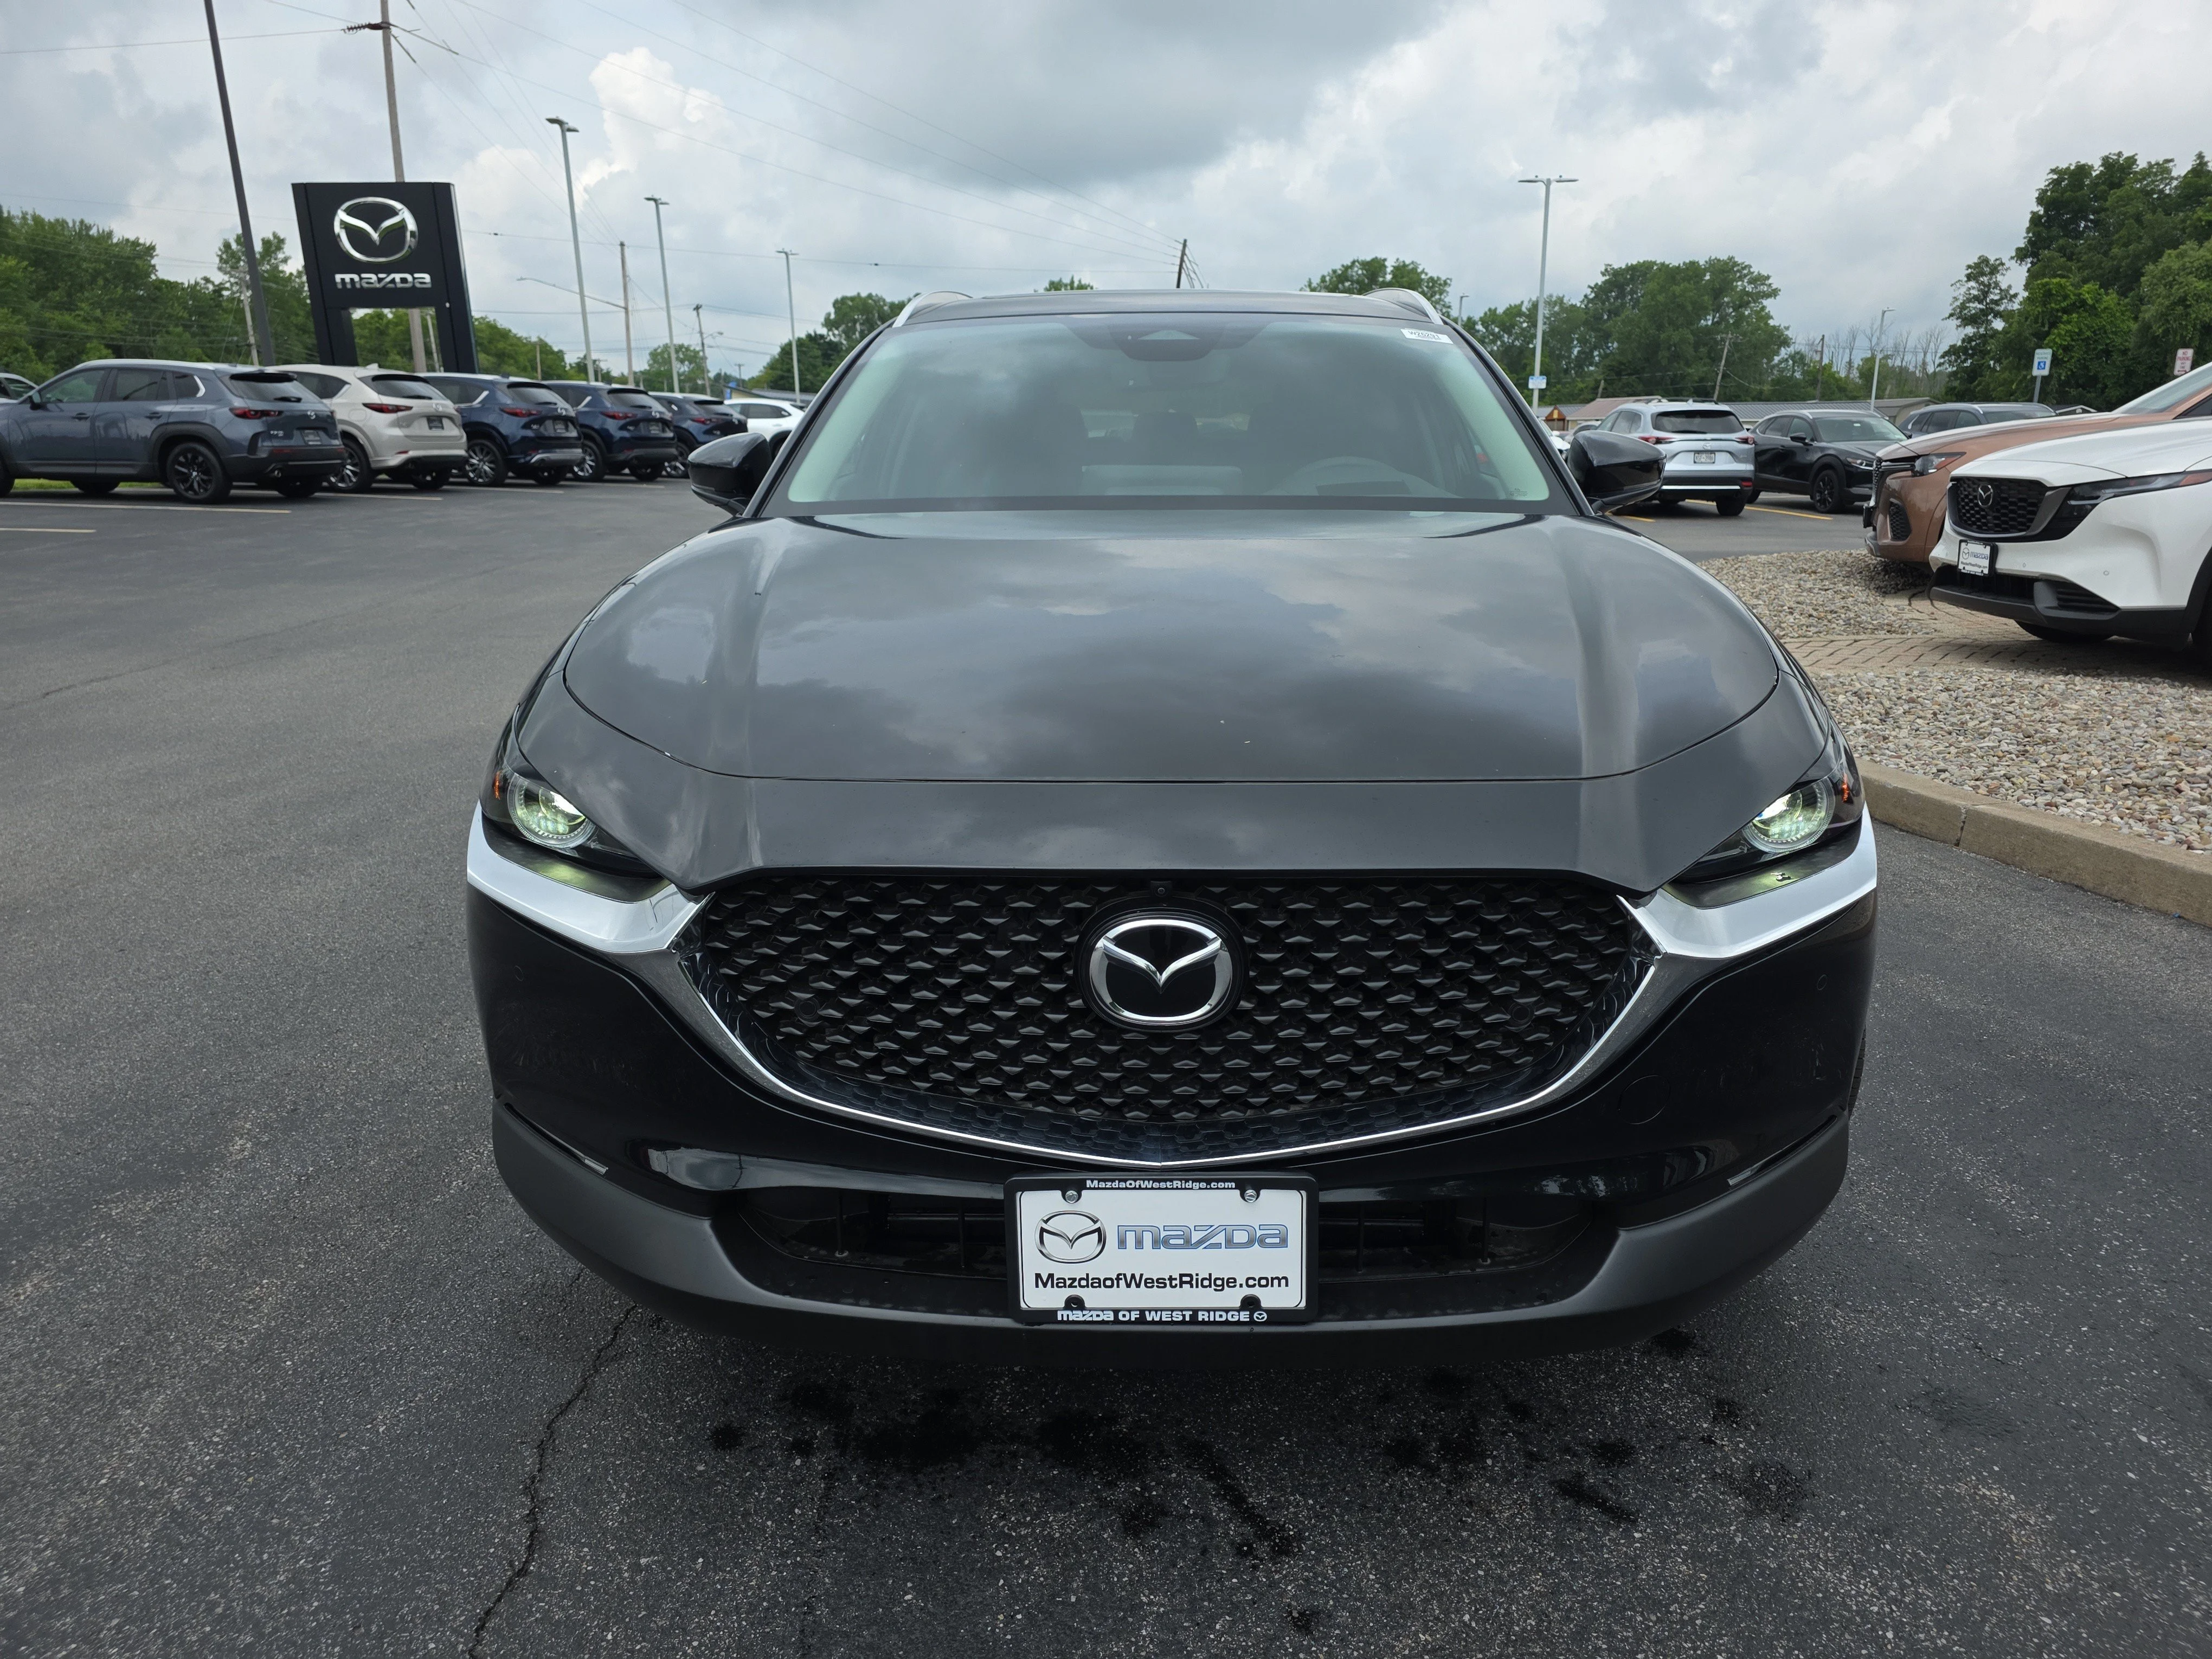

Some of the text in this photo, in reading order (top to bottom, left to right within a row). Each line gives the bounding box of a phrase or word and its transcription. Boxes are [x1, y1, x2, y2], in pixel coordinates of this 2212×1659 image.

[1086, 1180, 1236, 1189] MazdaOfWestRidge.com
[1034, 1273, 1289, 1292] MazdaofWestRidge.com
[1118, 1311, 1139, 1321] OF
[1145, 1310, 1193, 1321] WEST
[1198, 1311, 1250, 1321] RIDGE
